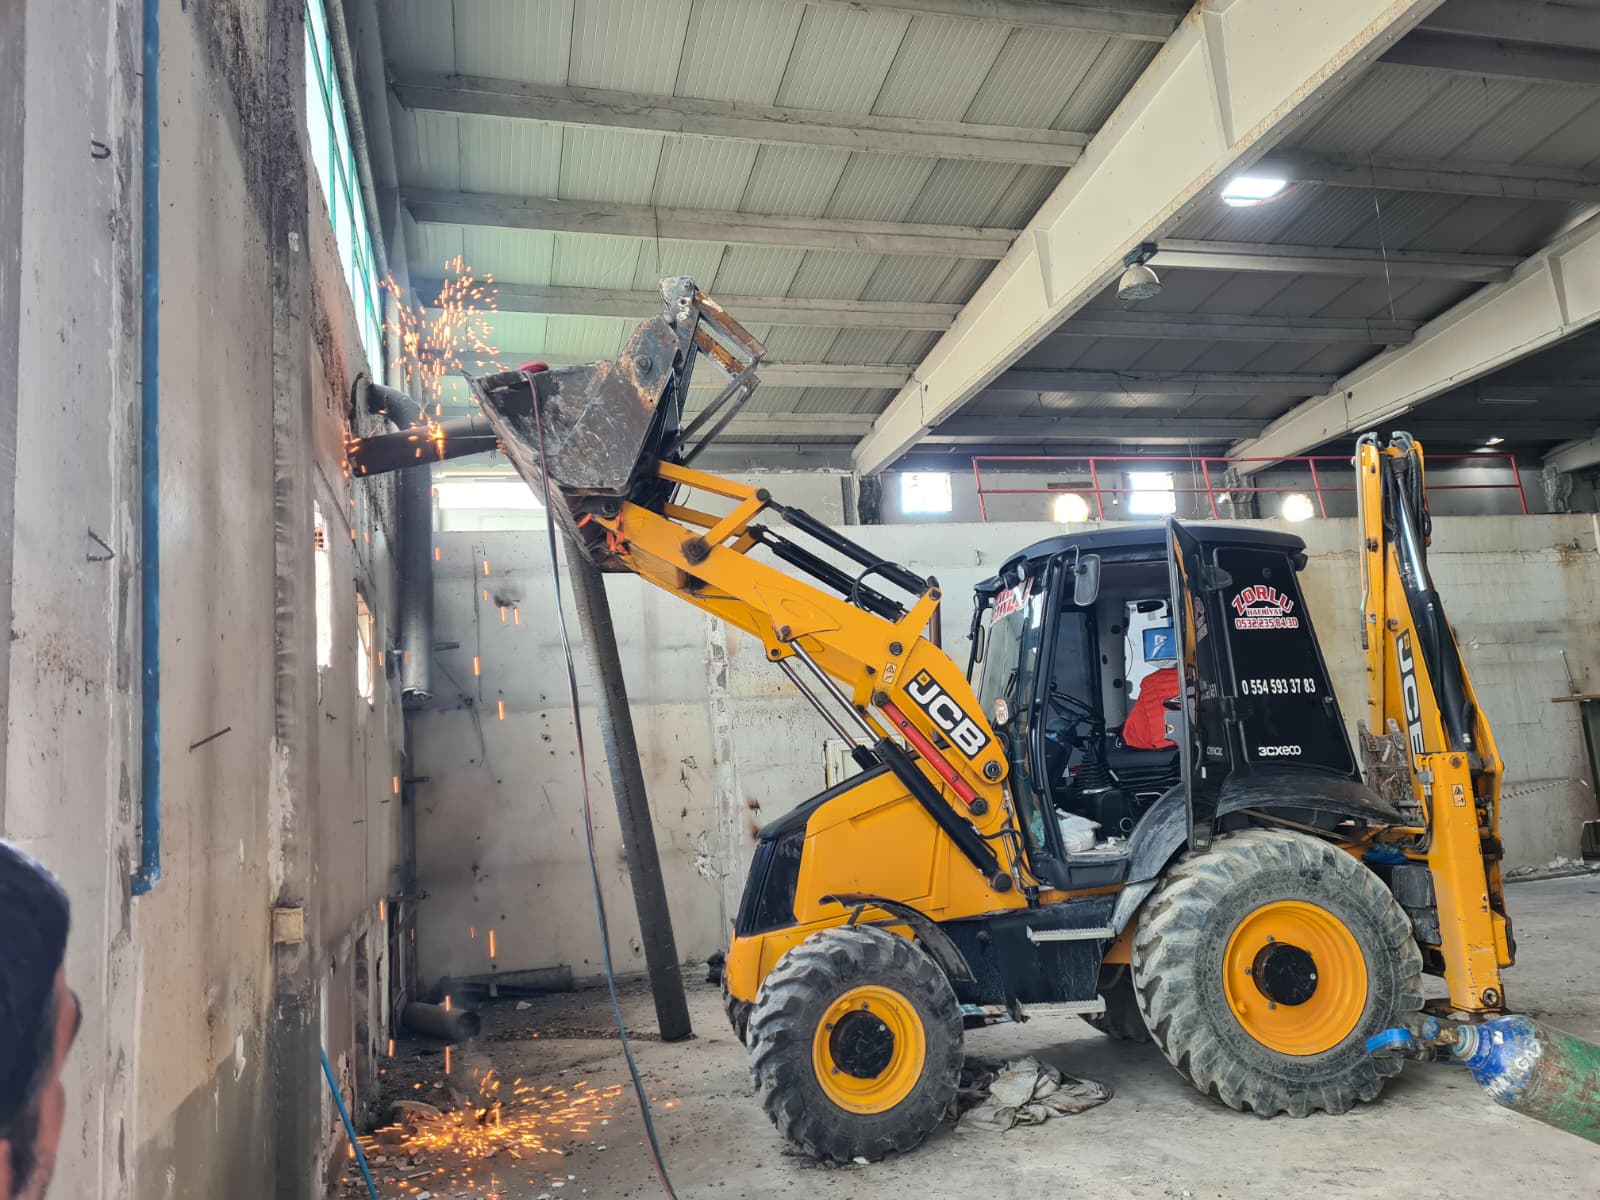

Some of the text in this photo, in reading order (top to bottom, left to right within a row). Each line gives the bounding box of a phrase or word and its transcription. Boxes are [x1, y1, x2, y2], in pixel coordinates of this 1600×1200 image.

[1232, 585, 1294, 616] ZORLU
[1235, 618, 1256, 629] 0532
[1257, 618, 1274, 629] 235
[1242, 678, 1316, 695] 0 554 593 37 83
[908, 681, 986, 755] JCB
